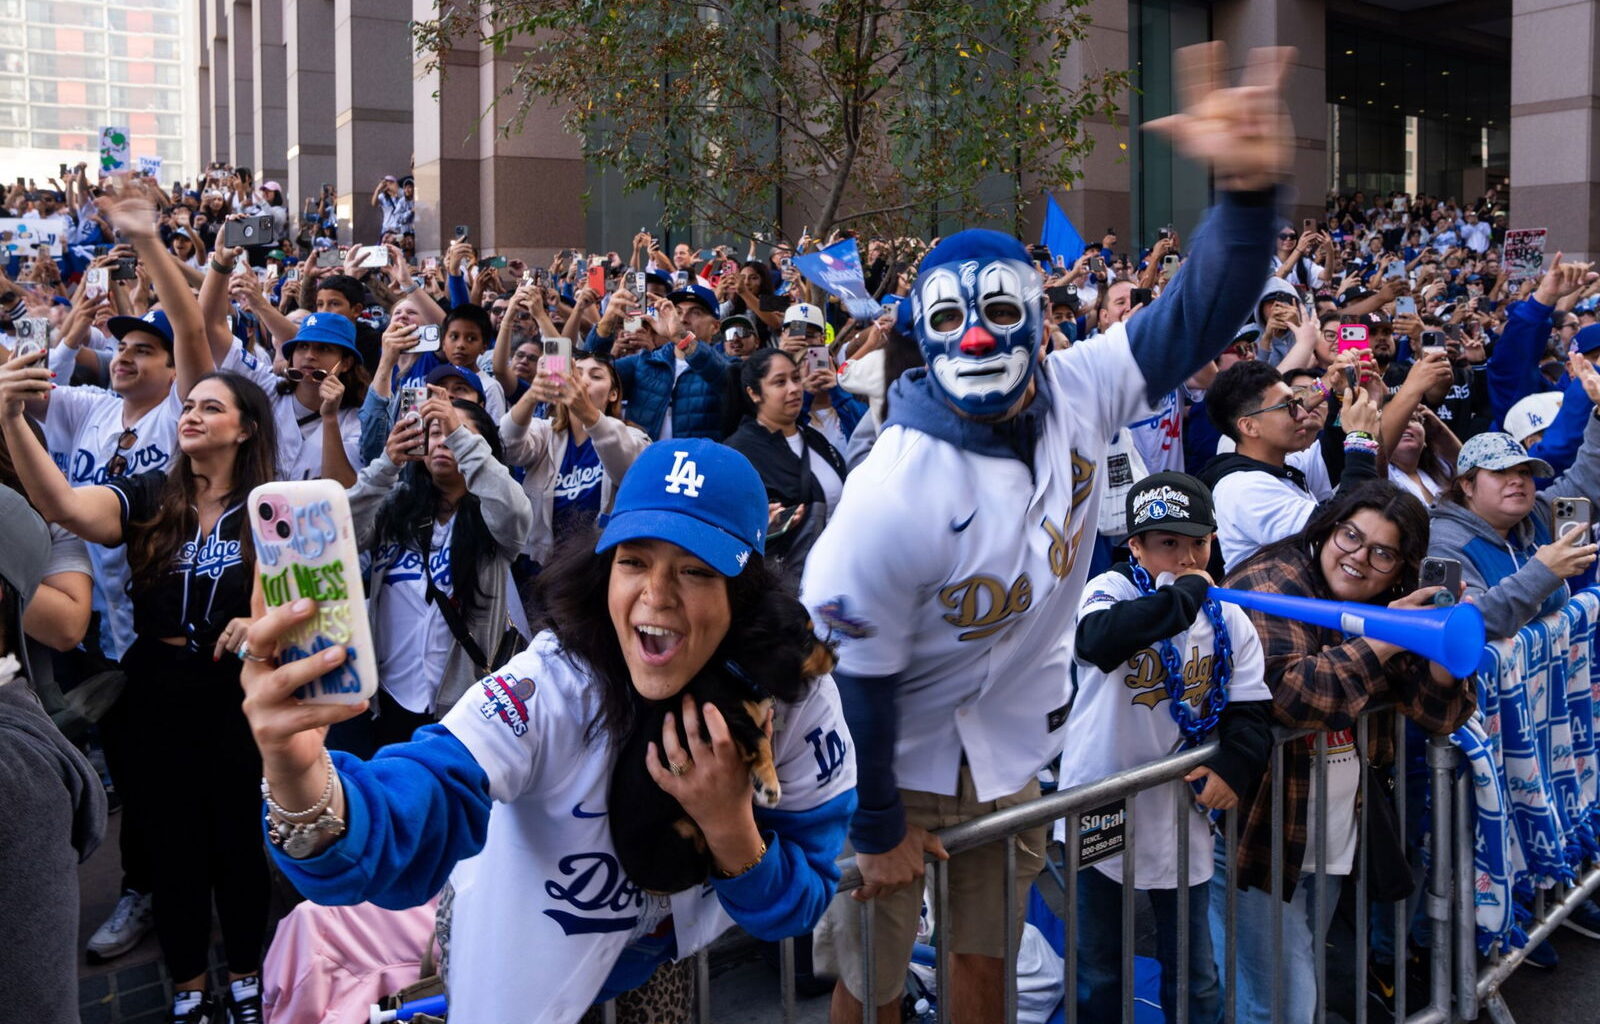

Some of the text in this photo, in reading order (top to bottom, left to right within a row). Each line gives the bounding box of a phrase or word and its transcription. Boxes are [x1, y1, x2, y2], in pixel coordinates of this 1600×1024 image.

[1527, 412, 1543, 427] LA
[664, 450, 705, 498] LA
[1151, 502, 1164, 517] LA
[804, 727, 846, 790] LA
[1526, 818, 1557, 858] LA
